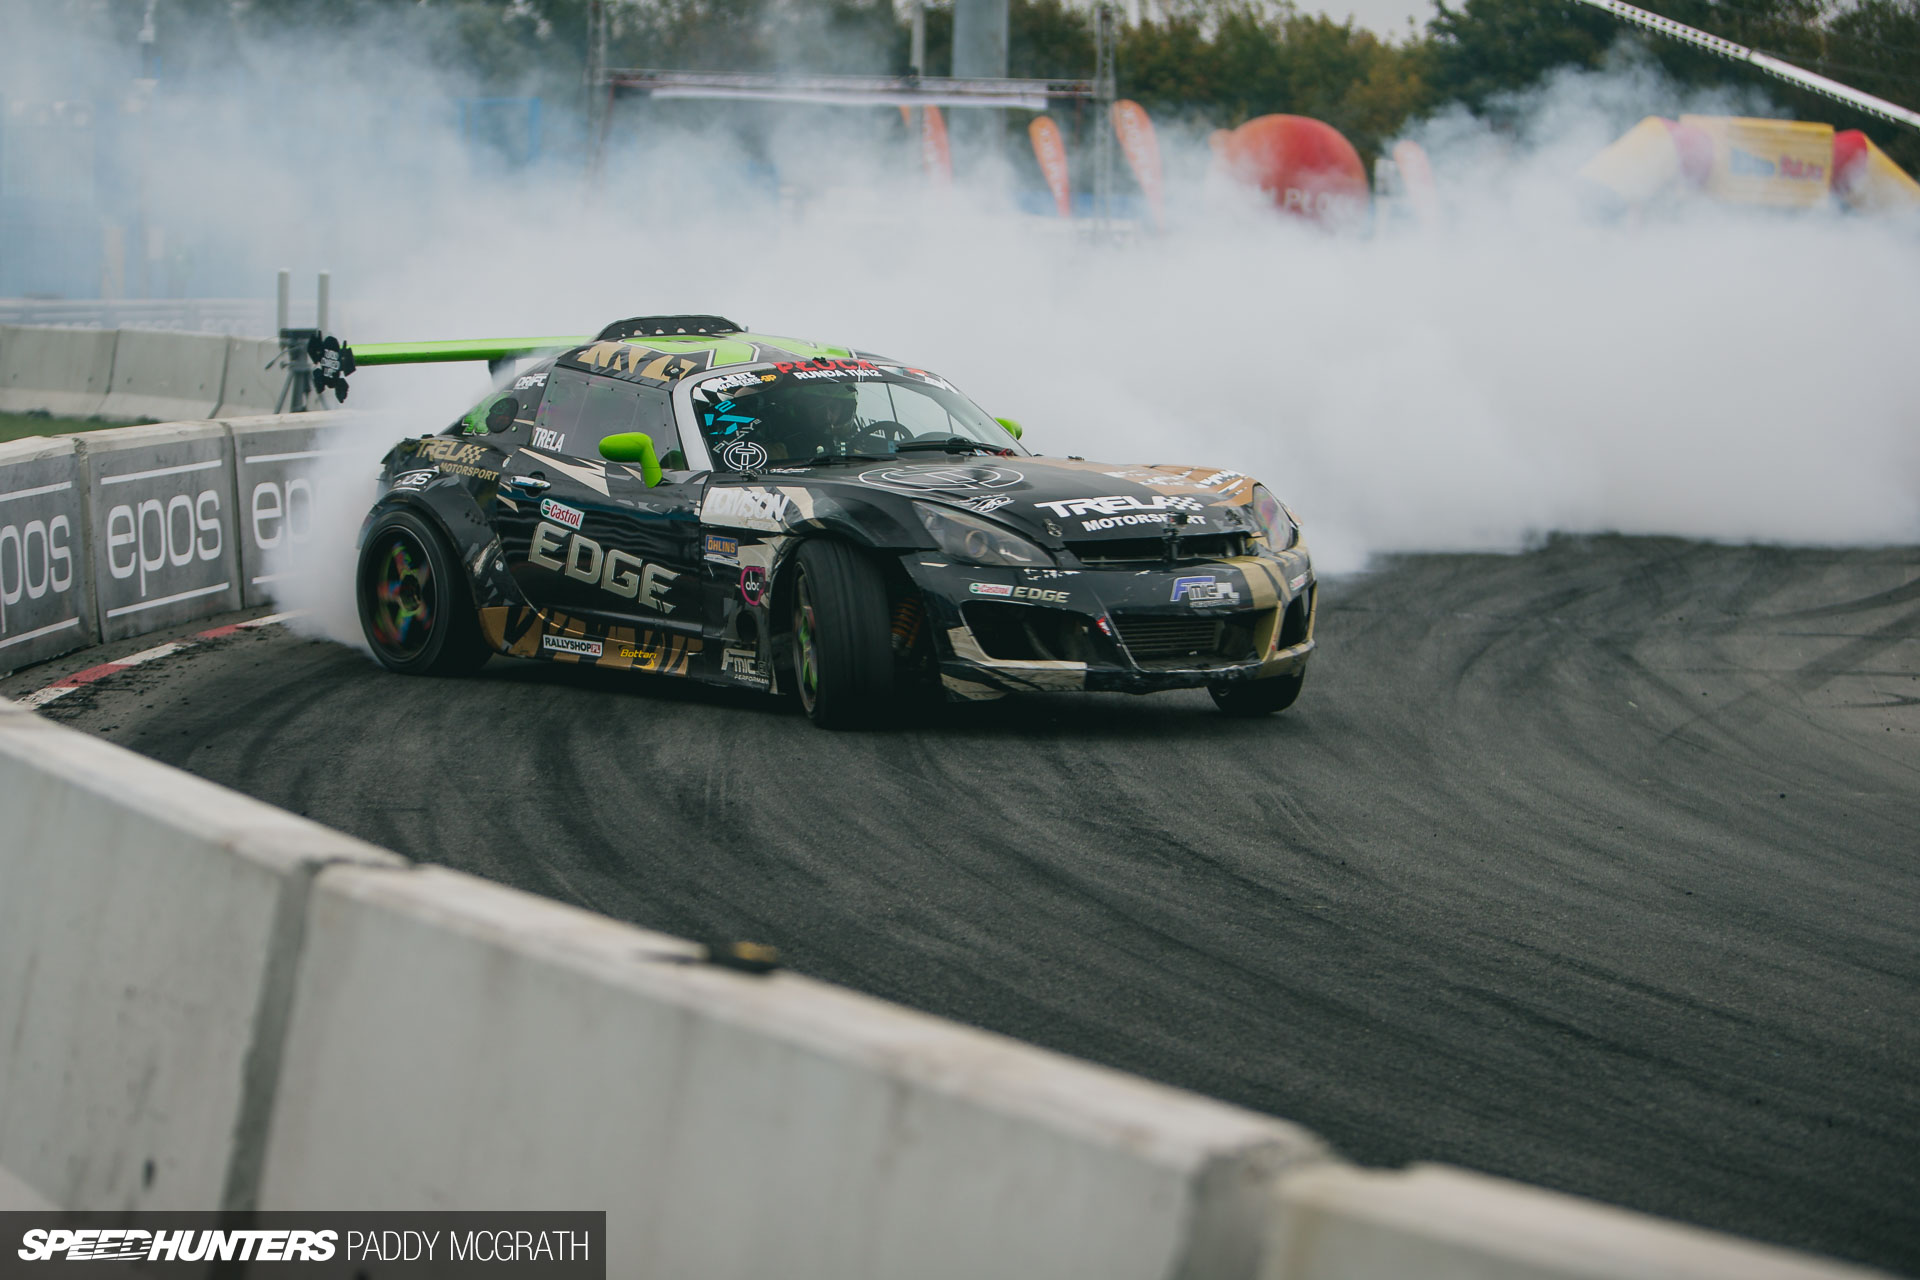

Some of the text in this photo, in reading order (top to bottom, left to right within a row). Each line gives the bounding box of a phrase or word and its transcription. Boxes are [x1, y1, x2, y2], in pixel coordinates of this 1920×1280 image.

[793, 370, 845, 380] RUNDA
[415, 439, 474, 463] TRELA
[532, 427, 566, 453] TRELA
[440, 462, 500, 482] MOTORSPORT
[550, 503, 581, 527] Castrol
[1034, 496, 1172, 518] TRELA
[1081, 512, 1207, 532] MOTORSPRT
[106, 489, 223, 597] epos
[708, 536, 736, 553] ÖHLINS
[528, 521, 681, 614] EDGE
[745, 570, 760, 592] abc
[1012, 586, 1071, 603] EDGE
[620, 649, 657, 660] Bottari
